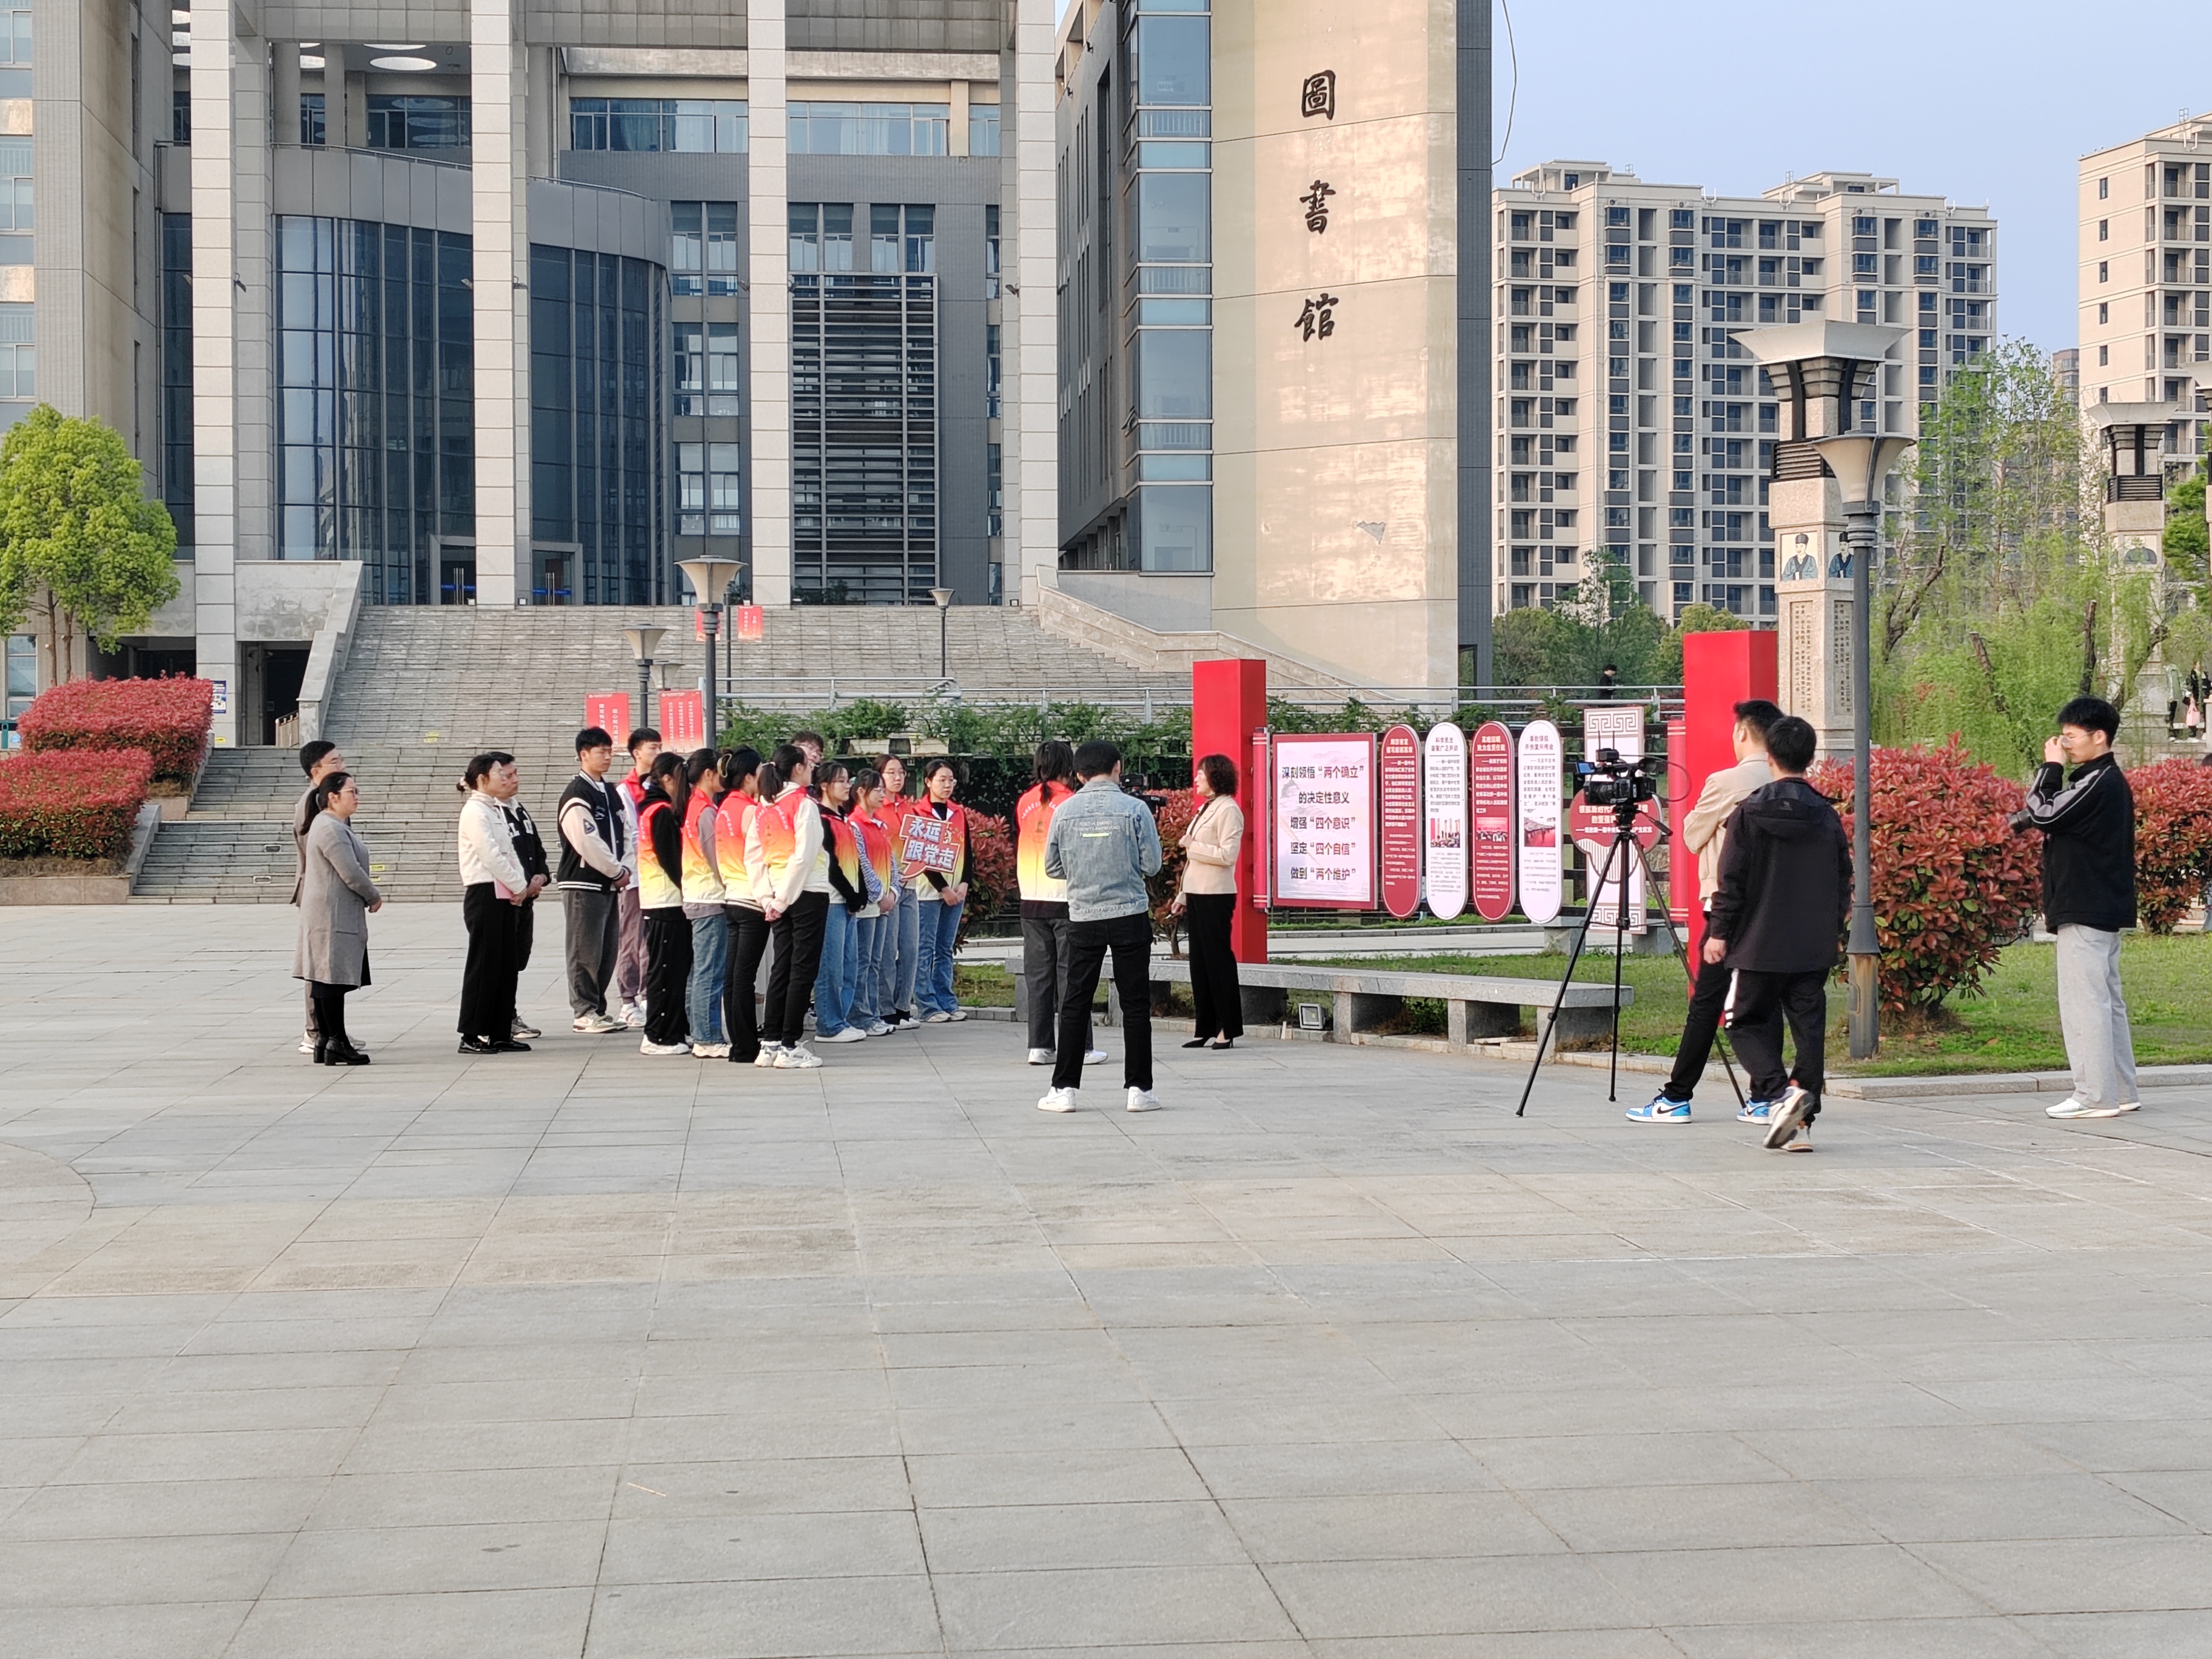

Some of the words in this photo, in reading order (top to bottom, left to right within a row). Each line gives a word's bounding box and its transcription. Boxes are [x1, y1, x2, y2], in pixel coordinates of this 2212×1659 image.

[1294, 69, 1338, 342] 圖書館
[1282, 765, 1364, 779] 深刻领悟“两个确立”
[1298, 791, 1350, 804] 的决定性意义
[908, 817, 942, 843] 永远
[1290, 817, 1356, 830] 增强“四个意识”
[906, 840, 954, 869] 跟党走
[1290, 842, 1356, 855] 坚定“四个自信”
[1290, 866, 1356, 880] 做到“两个维护”
